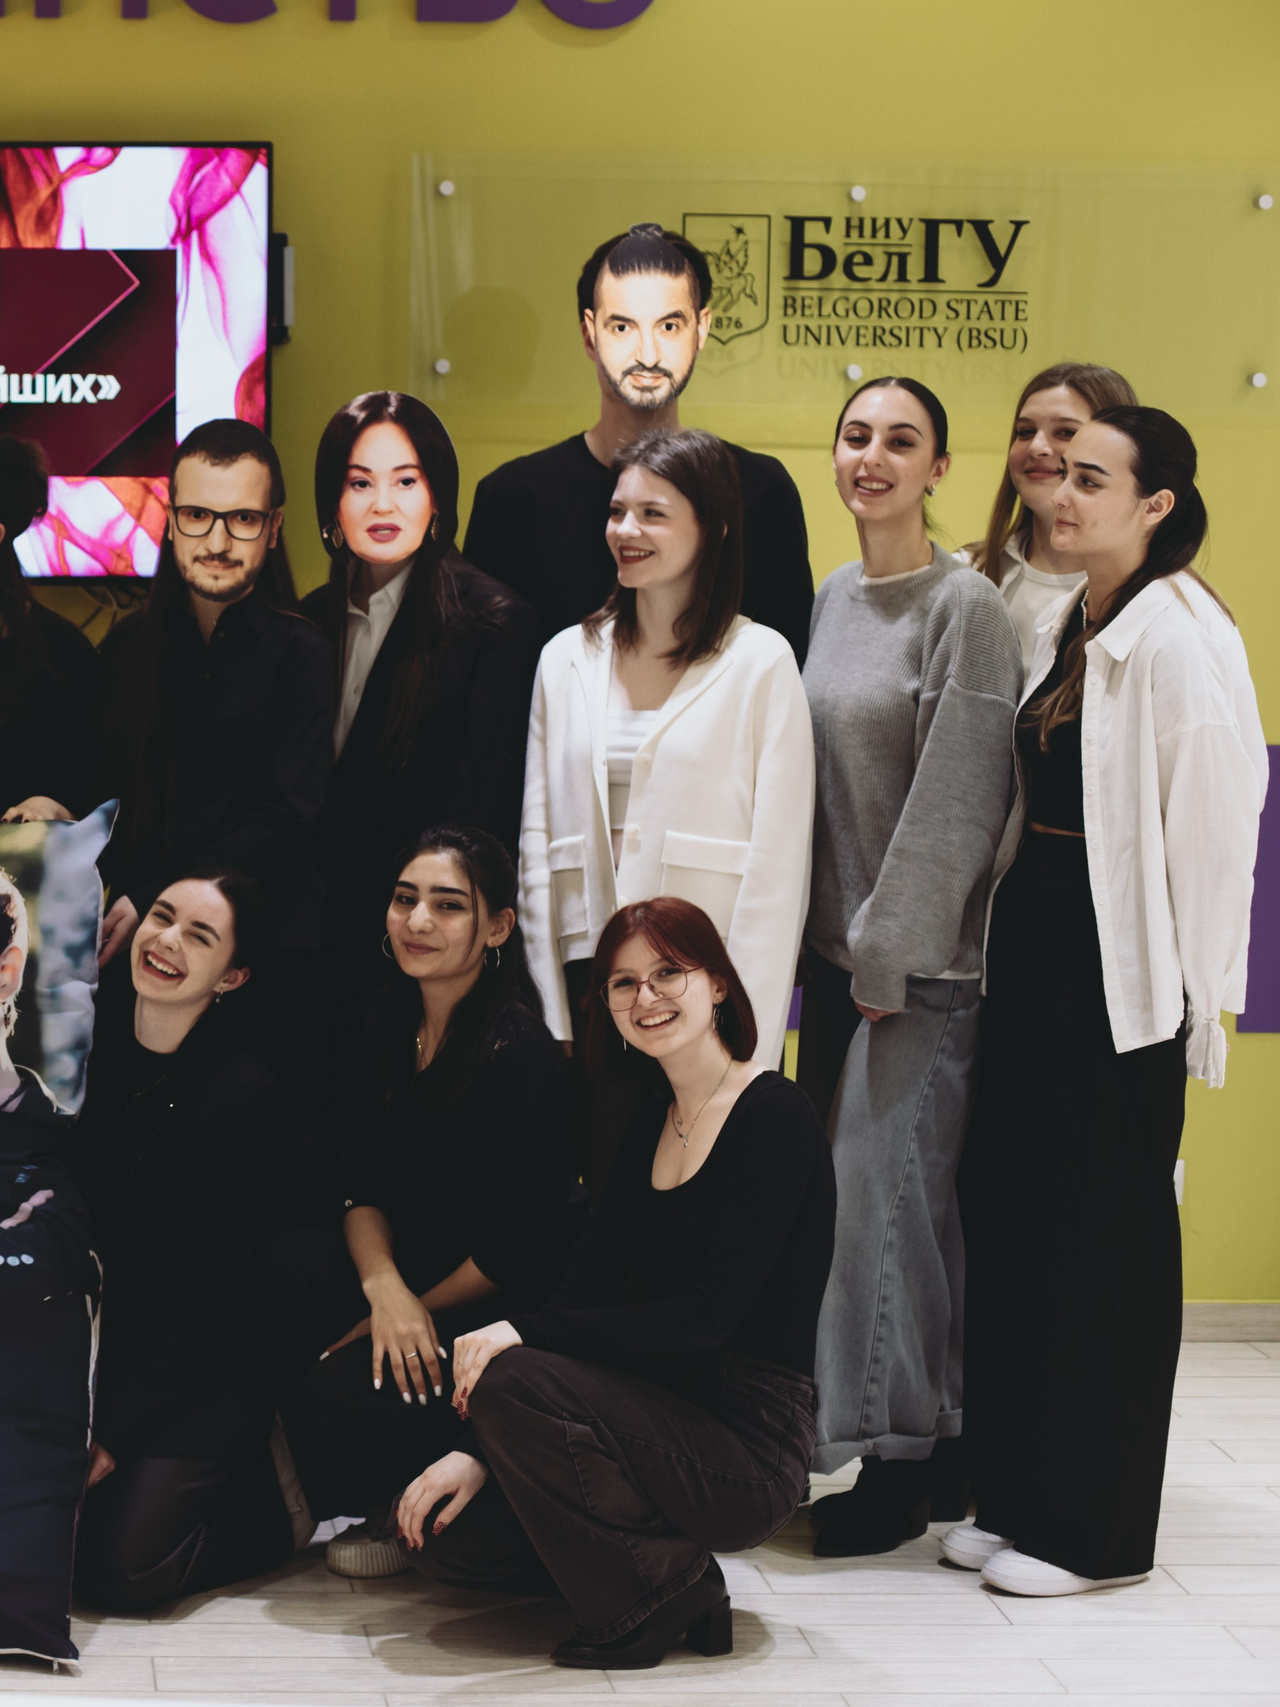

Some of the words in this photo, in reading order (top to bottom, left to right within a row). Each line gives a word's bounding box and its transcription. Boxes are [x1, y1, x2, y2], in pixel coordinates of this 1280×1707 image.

[844, 216, 914, 240] НИУ
[783, 215, 1031, 288] БелГУ
[783, 296, 938, 321] BELGOROD
[946, 298, 1028, 321] STATE
[710, 316, 743, 329] 876
[782, 324, 948, 348] UNIVERSITY
[956, 326, 1028, 353] (BSU)
